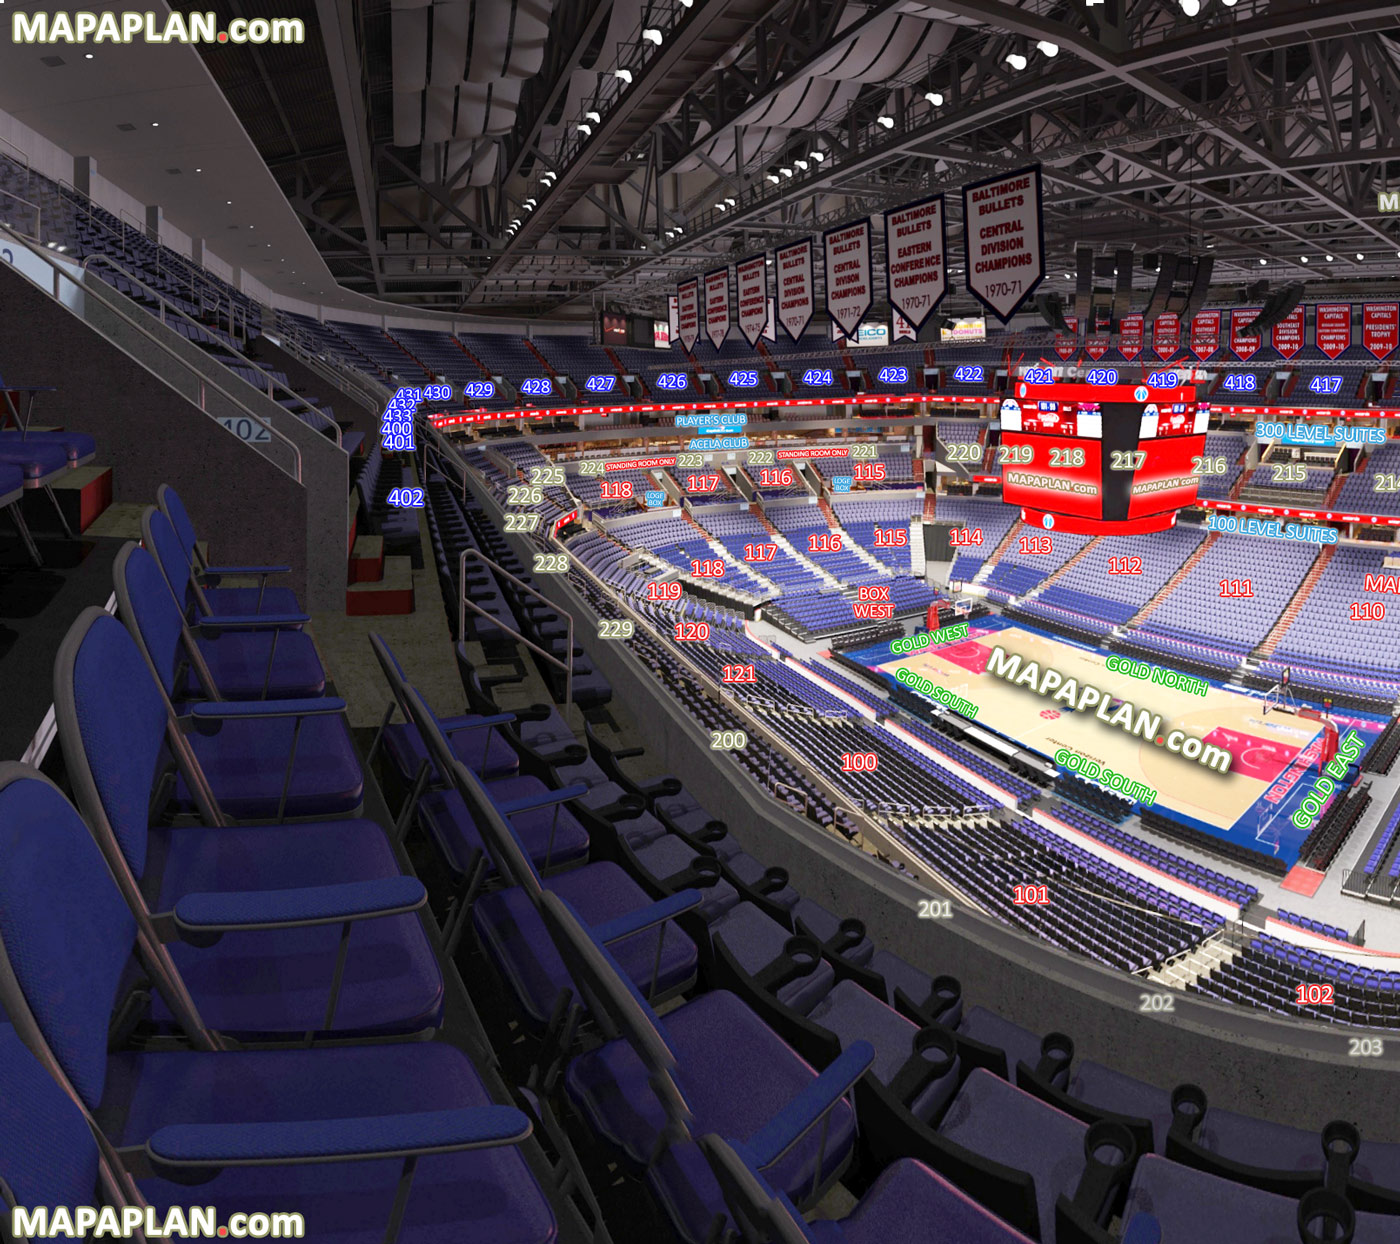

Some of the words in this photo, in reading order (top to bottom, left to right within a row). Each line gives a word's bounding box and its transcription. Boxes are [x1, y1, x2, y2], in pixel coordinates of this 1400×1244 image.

[972, 177, 1030, 202] BALTIMORE
[979, 195, 1024, 216] BULLETS
[892, 205, 936, 225] BALTIMORE
[829, 227, 864, 245] BALTIMORE
[897, 220, 931, 237] BULLETS
[980, 220, 1024, 239] CENTRAL
[833, 240, 860, 255] BULLETS
[898, 241, 931, 258] EASTERN
[981, 237, 1023, 256] DIVISION
[834, 259, 860, 273] CENTRAL
[891, 255, 941, 274] CONFERENCE
[975, 253, 1032, 273] CHAMPIONS
[894, 271, 938, 288] CHAMPIONS
[831, 285, 866, 300] CHAMPIONS
[985, 280, 1022, 298] 1970-71
[902, 295, 930, 310] 1970-71
[837, 306, 860, 319] 1971-72
